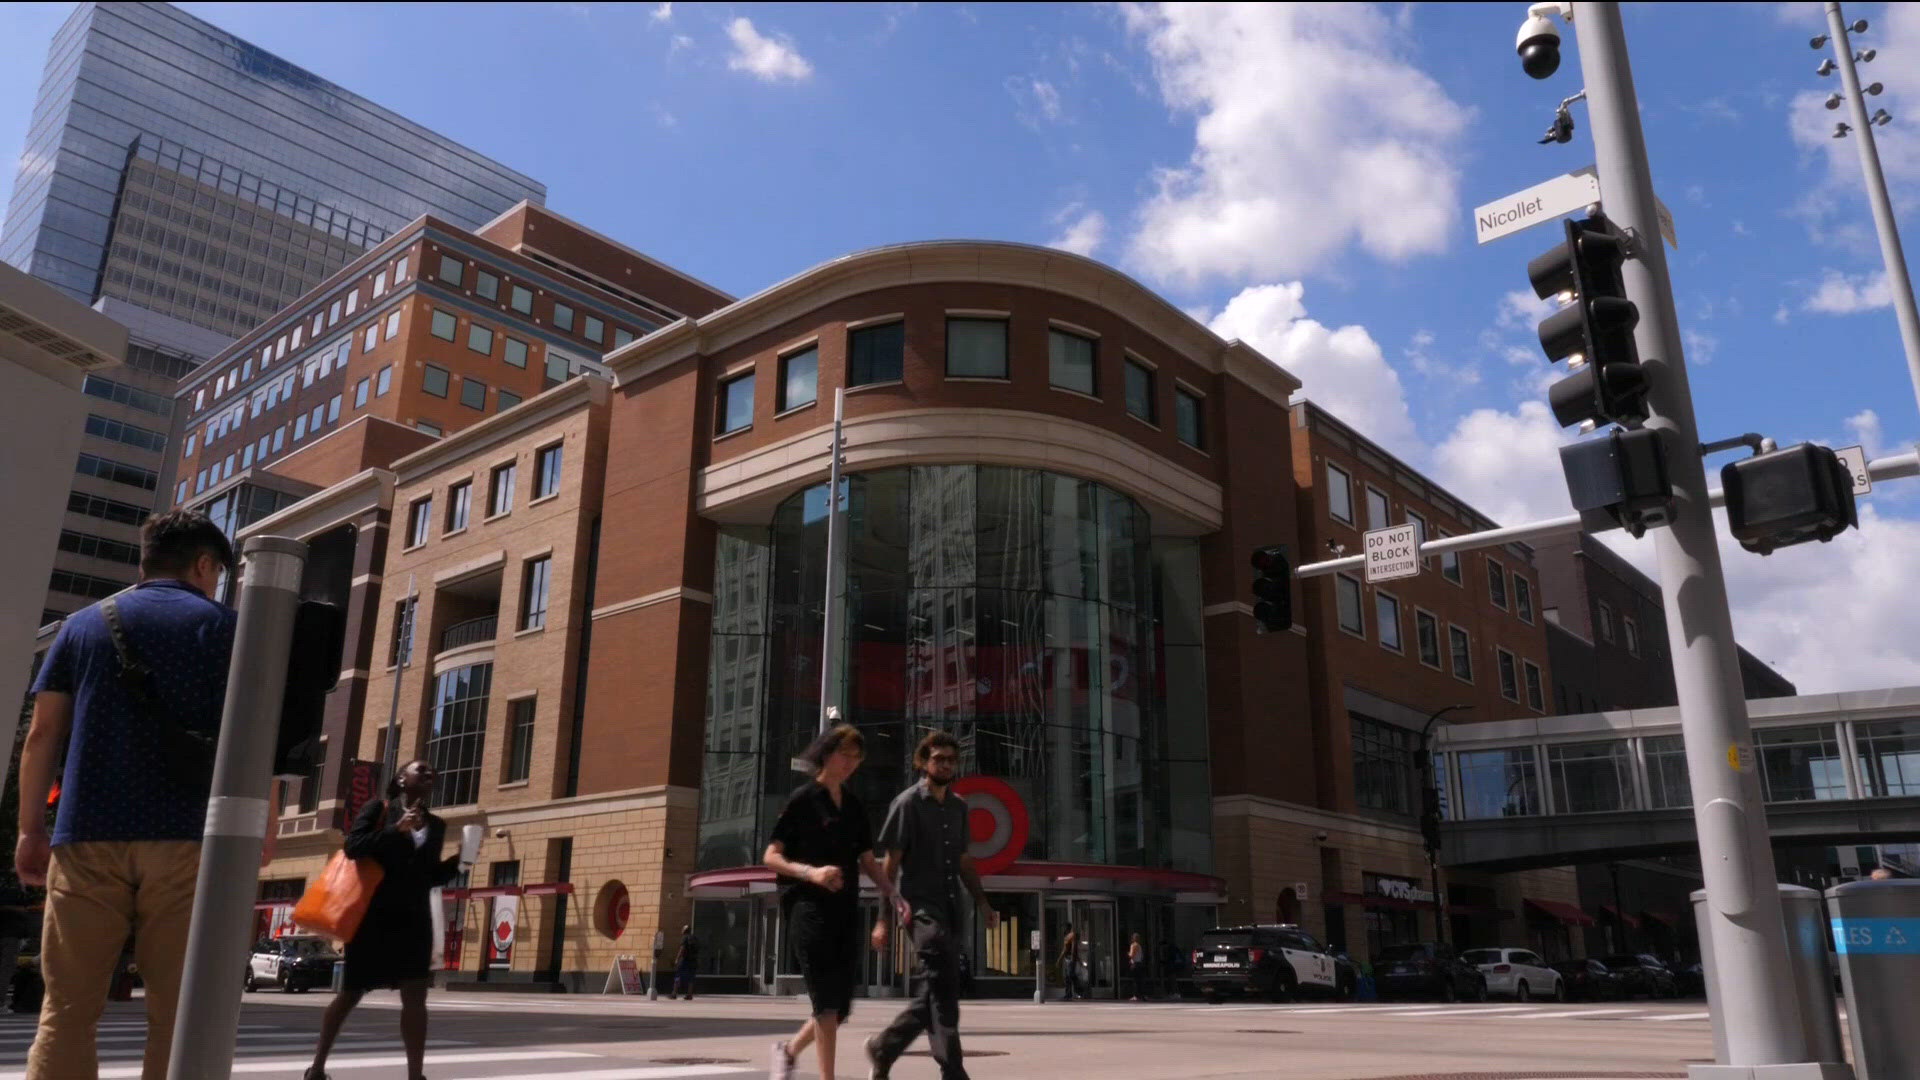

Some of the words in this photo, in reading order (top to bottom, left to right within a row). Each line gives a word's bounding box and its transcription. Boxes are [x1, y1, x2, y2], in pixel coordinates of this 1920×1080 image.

[1480, 197, 1543, 233] Nicollet
[1369, 536, 1383, 548] DO
[1389, 530, 1411, 544] NOT
[1372, 546, 1410, 562] BLOCK
[1369, 560, 1414, 575] INTERSECTION
